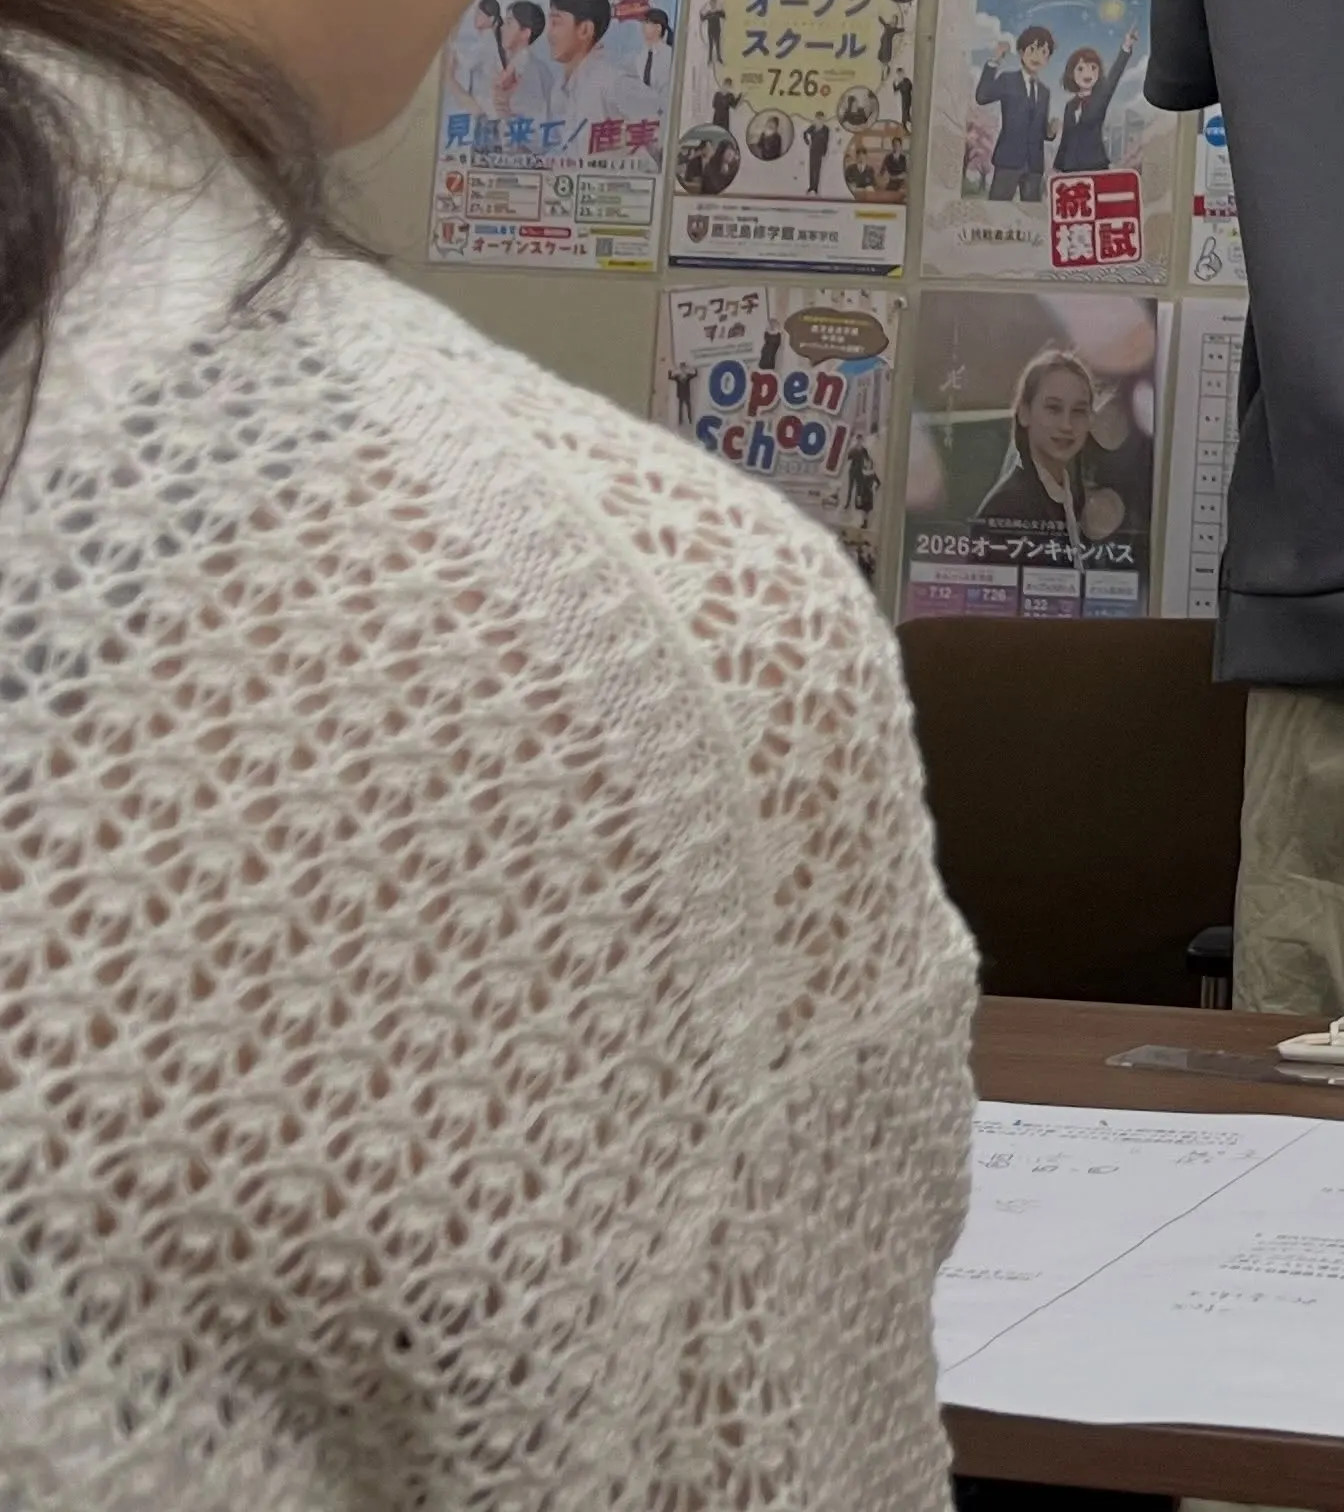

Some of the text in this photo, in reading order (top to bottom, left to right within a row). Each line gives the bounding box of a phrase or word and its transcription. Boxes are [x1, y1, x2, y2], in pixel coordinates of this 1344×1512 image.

[741, 28, 867, 60] スクール
[1054, 180, 1138, 220] 統一
[1055, 222, 1139, 263] 模試
[708, 359, 845, 417] Open
[916, 533, 1136, 564] 2026オープンキャンパス
